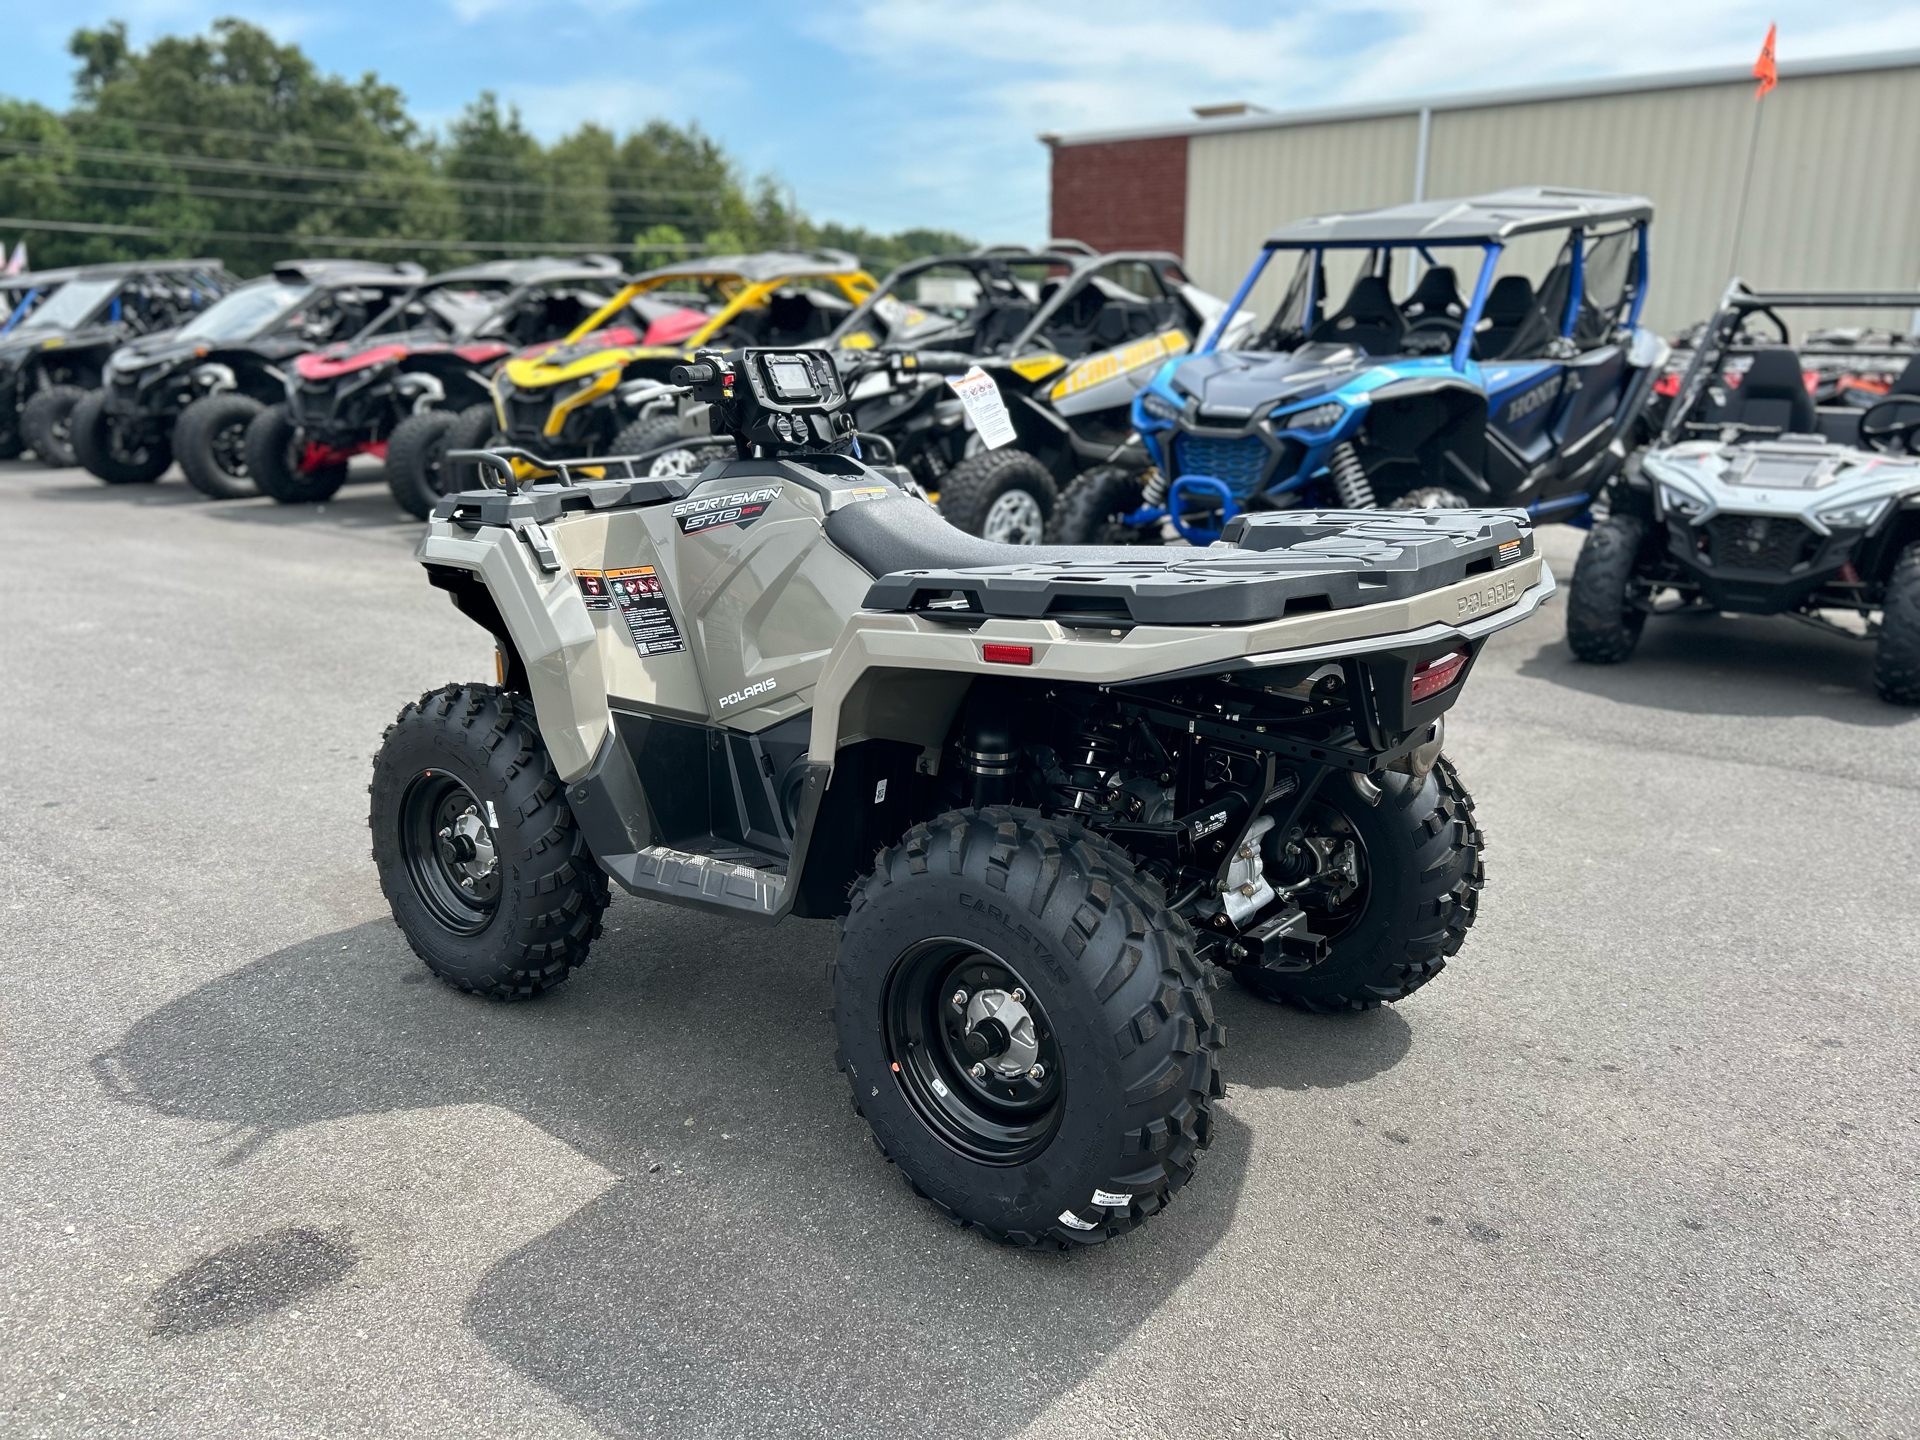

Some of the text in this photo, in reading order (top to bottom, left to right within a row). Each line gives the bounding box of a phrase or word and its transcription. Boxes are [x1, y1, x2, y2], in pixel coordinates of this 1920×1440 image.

[671, 487, 783, 516] SPORTSMAN
[684, 506, 763, 530] 570 EFI
[1457, 580, 1516, 619] POLARIS
[718, 677, 777, 709] POLARIS
[959, 892, 1070, 985] CARLSTAR
